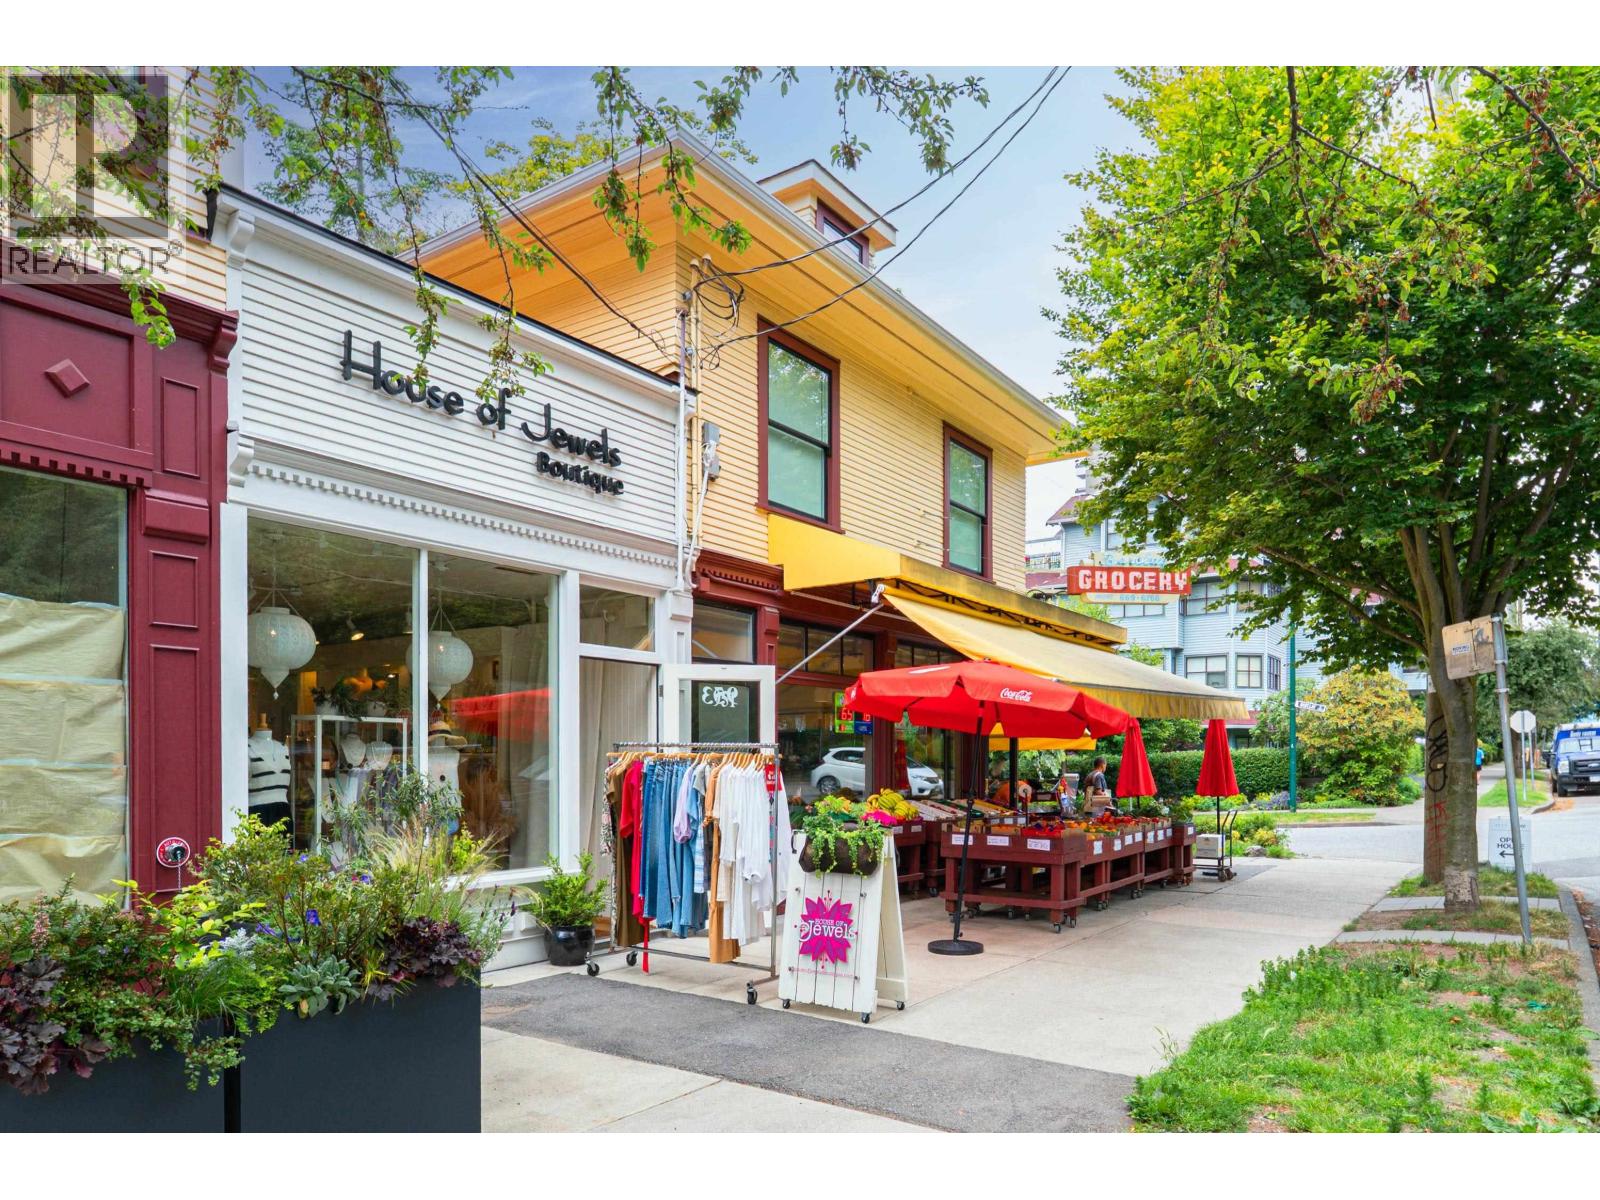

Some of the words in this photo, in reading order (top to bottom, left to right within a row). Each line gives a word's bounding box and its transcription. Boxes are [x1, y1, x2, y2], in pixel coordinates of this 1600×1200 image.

[339, 329, 464, 416] House
[475, 387, 512, 431] of
[521, 402, 622, 468] Jewels
[536, 451, 625, 496] Boutique
[1078, 569, 1187, 591] GROCERY
[1000, 687, 1033, 702] Coca-Cola
[799, 919, 857, 942] Jewels
